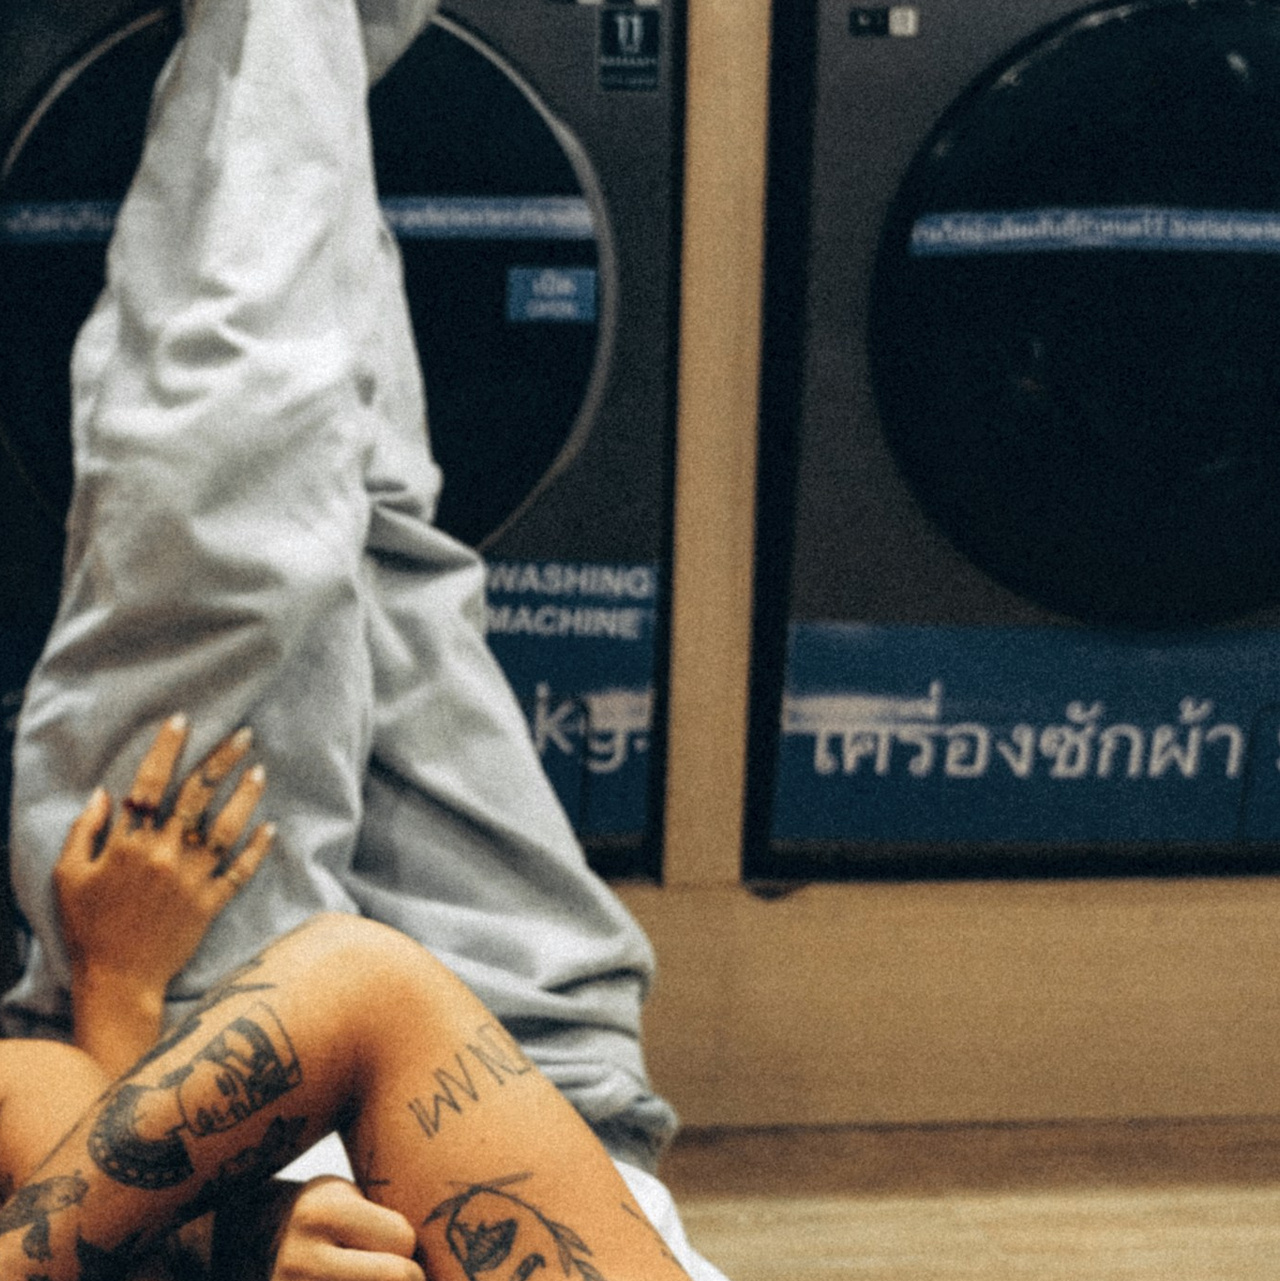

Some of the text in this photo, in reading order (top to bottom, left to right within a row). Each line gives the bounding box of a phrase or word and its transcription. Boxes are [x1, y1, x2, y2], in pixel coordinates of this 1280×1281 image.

[486, 563, 657, 599] WASHING
[487, 604, 643, 641] MACHINE
[814, 680, 1243, 780] เคร่องซักผ้า
